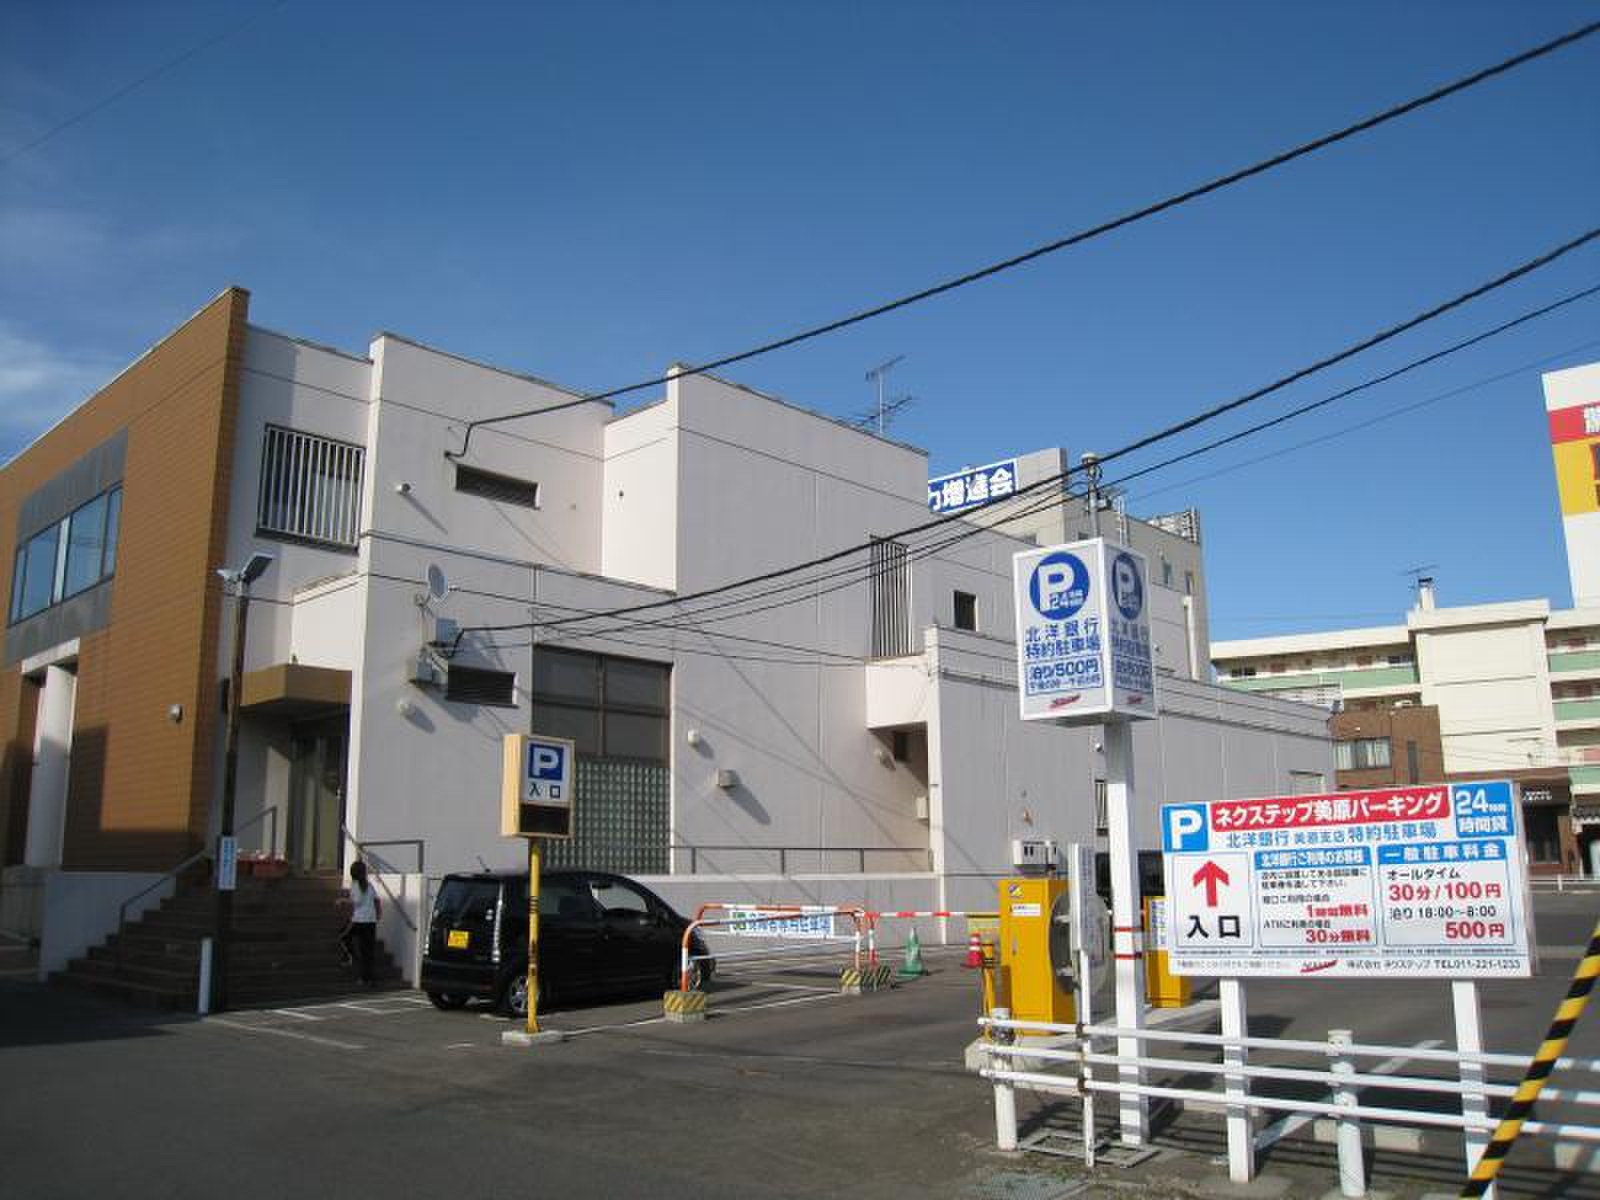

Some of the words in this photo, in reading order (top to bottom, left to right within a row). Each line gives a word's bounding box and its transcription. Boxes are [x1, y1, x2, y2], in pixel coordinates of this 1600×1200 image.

[1038, 563, 1074, 612] P
[1026, 617, 1099, 642] 北洋銀行
[1025, 635, 1101, 659] 特約駐車場
[532, 747, 559, 776] P
[529, 783, 560, 799] 入口
[1456, 789, 1488, 815] 24
[1216, 792, 1443, 827] ネクステップ美原パーキング
[1170, 809, 1202, 849] P
[1227, 830, 1290, 848] 北洋銀行
[1349, 822, 1437, 843] 特約駐車場
[1384, 842, 1501, 861] 一般駐車料金
[1387, 867, 1460, 880] オールタイム
[1389, 906, 1413, 921] 泊り
[1187, 915, 1241, 939] 入口
[1445, 921, 1505, 939] 500円
